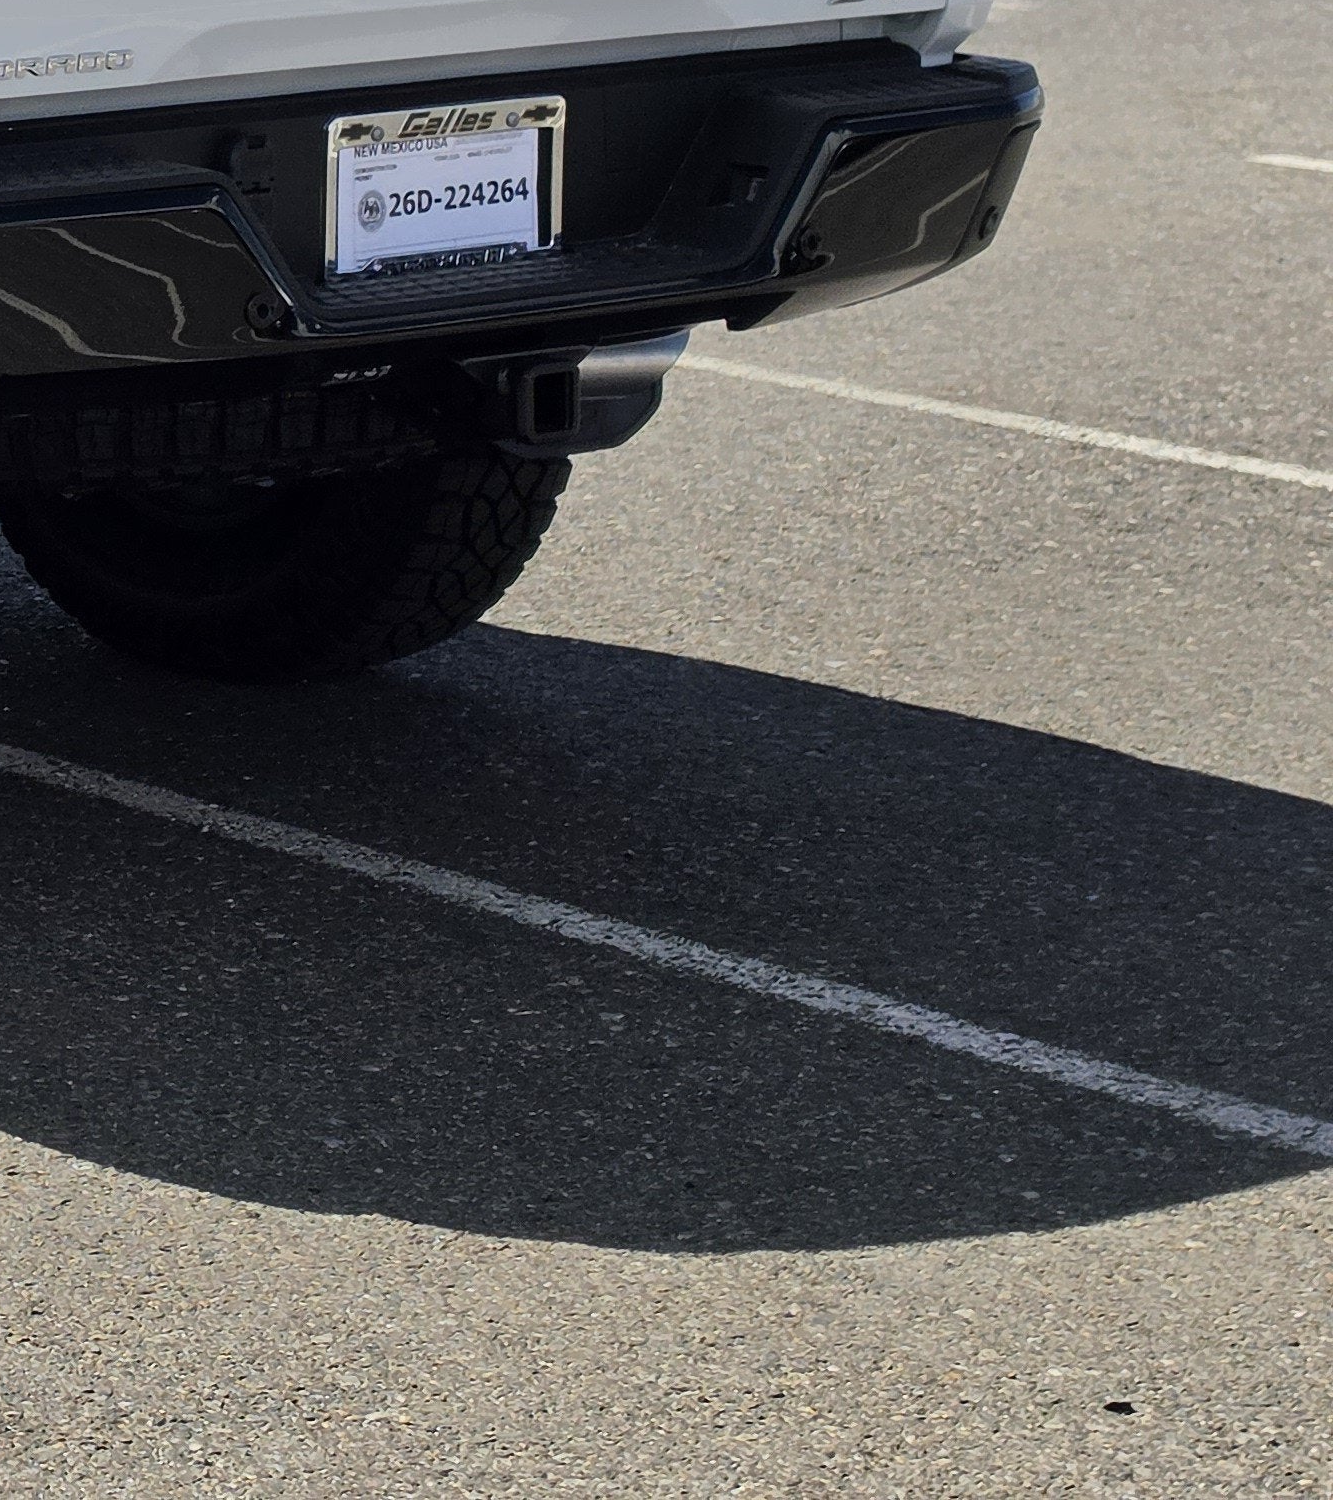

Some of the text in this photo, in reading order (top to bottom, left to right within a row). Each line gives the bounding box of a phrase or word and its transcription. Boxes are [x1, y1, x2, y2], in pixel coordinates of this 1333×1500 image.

[398, 108, 497, 139] Galles
[353, 145, 379, 159] NEW
[380, 140, 424, 155] MEXICO
[426, 137, 448, 151] USA
[388, 176, 530, 218] 26D-224264
